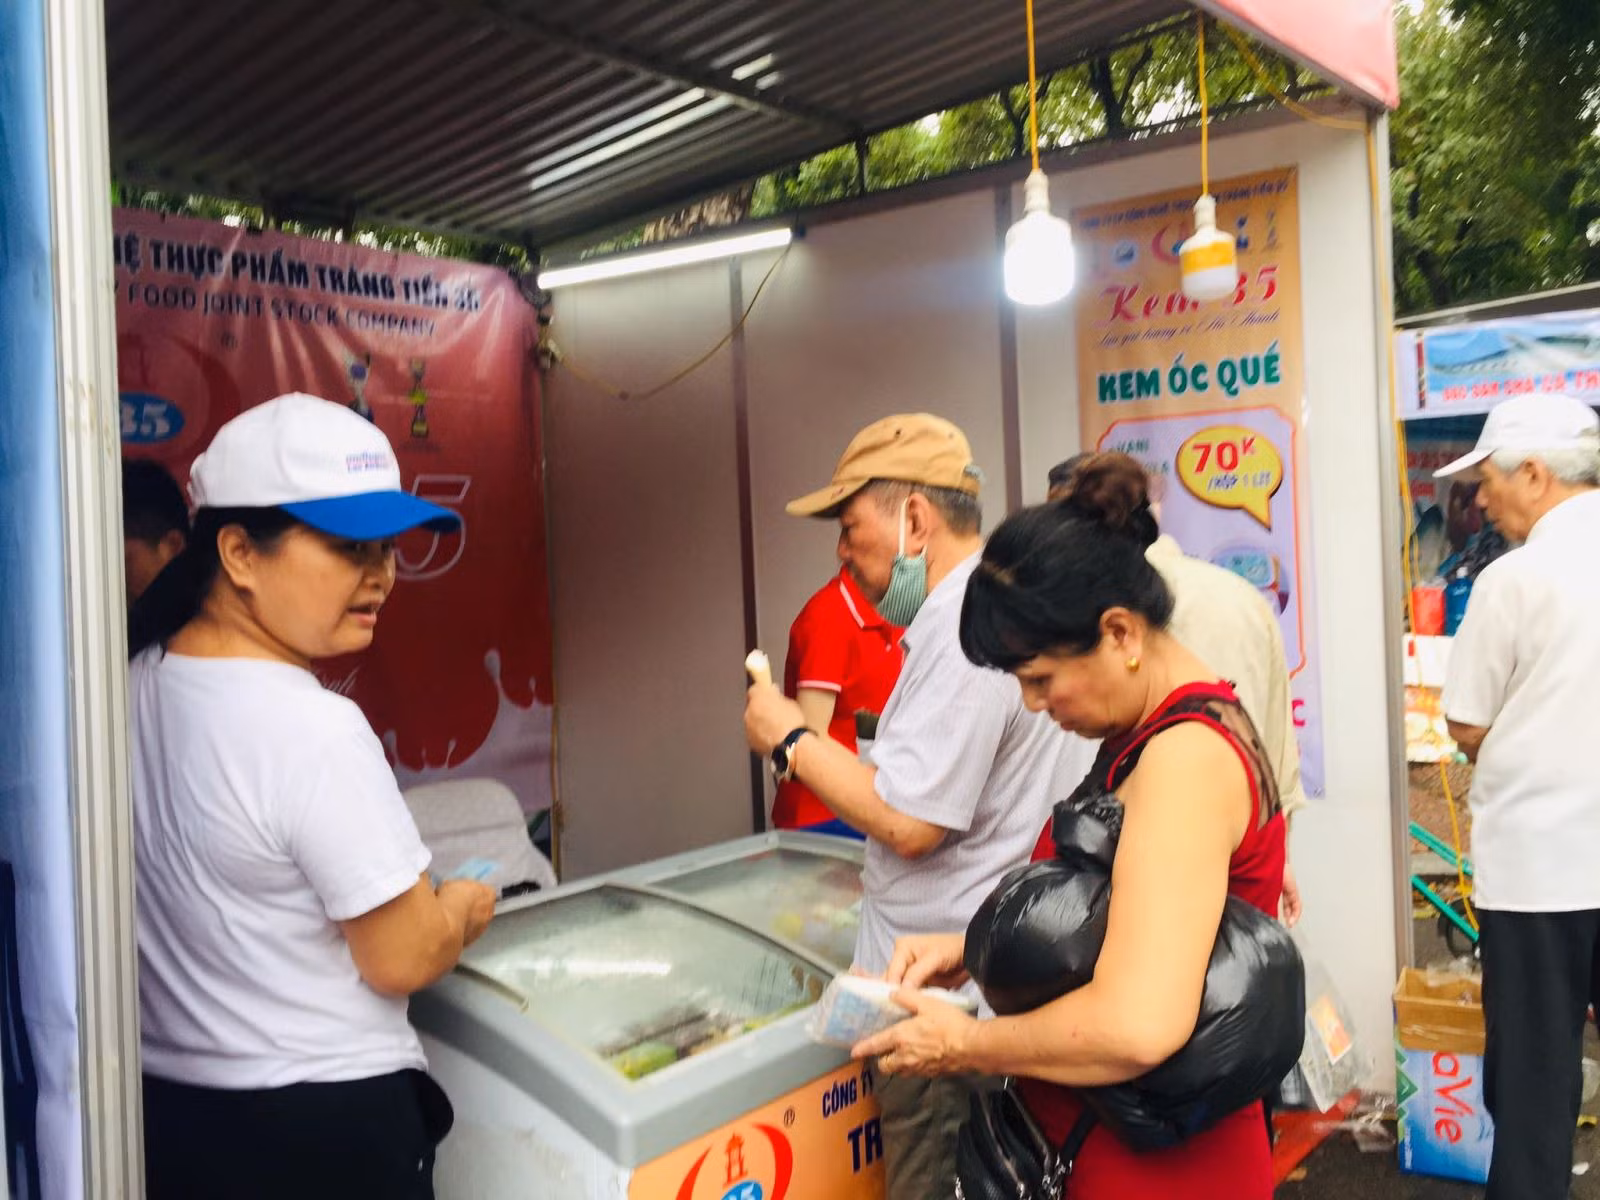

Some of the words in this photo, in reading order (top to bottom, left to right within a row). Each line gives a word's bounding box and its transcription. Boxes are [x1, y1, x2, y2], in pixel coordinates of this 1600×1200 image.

[149, 239, 225, 282] THỰC
[128, 282, 197, 312] FOOD
[203, 291, 263, 317] JOINT
[270, 297, 339, 326] STOCK
[345, 306, 436, 337] COMPANY
[1098, 365, 1161, 404] KEM
[822, 1077, 857, 1118] CÔNG
[1432, 1050, 1474, 1145] aVie
